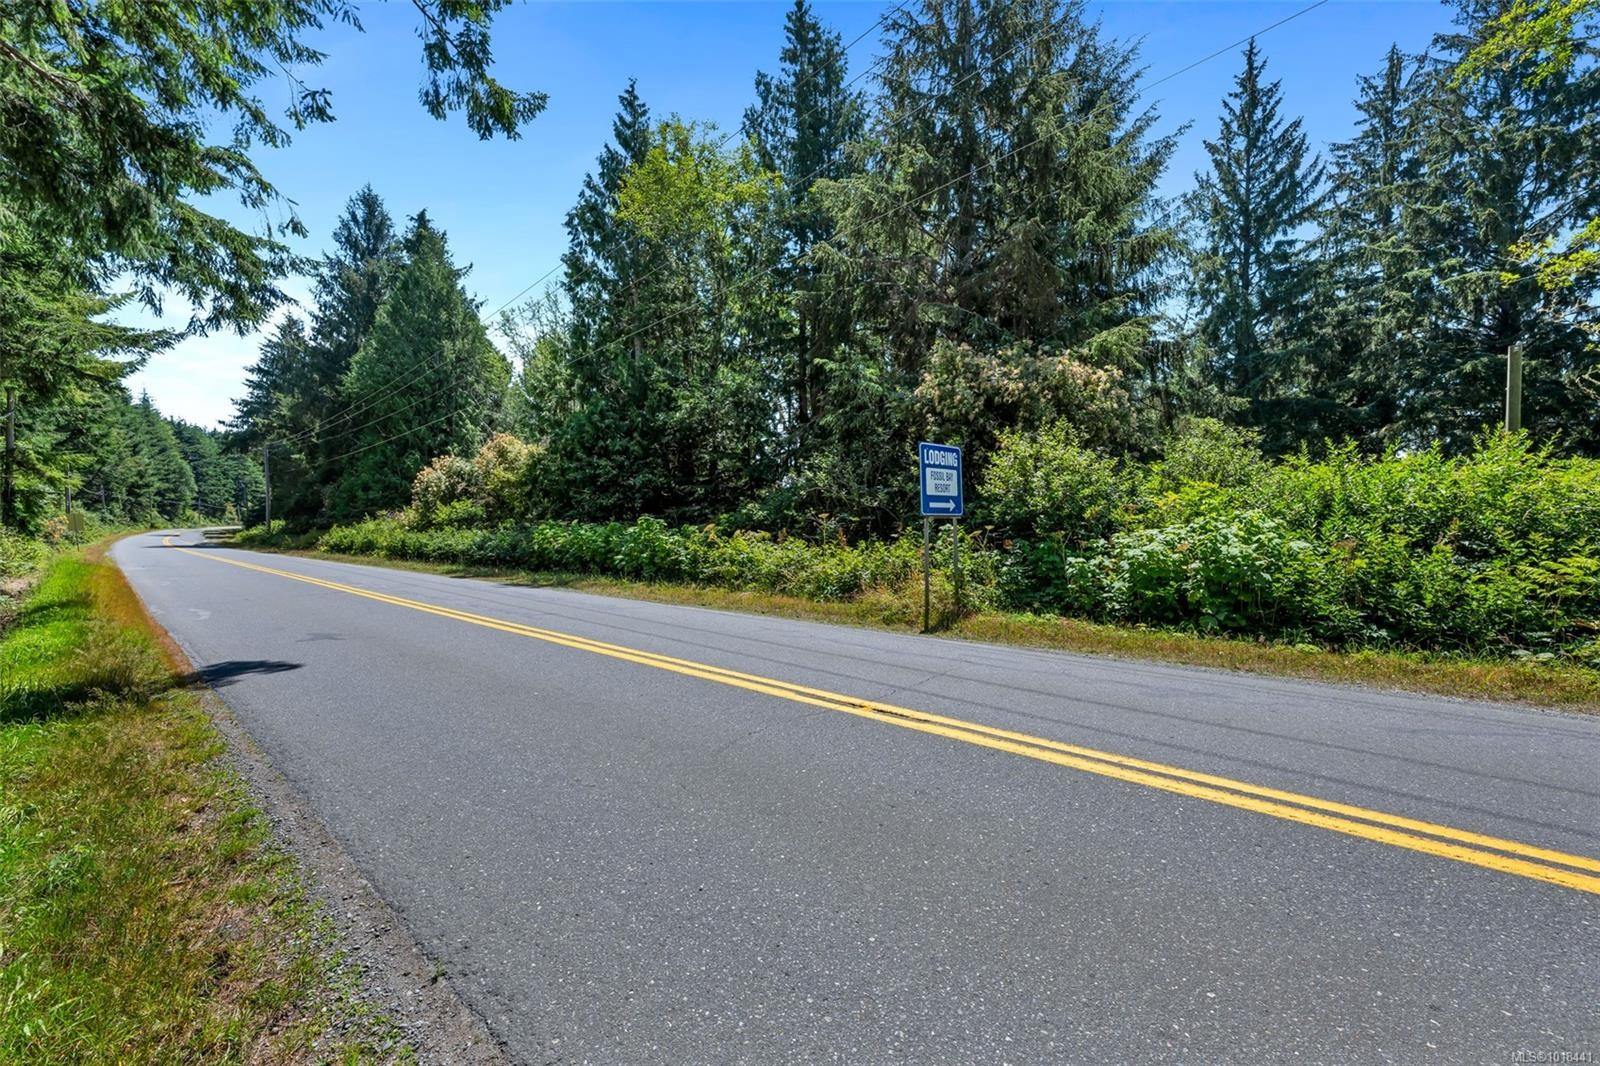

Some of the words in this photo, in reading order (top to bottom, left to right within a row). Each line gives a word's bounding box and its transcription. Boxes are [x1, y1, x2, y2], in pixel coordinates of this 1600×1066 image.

[924, 449, 958, 467] LODGING
[930, 470, 945, 481] FOSSIL
[945, 472, 953, 482] BAY
[935, 483, 951, 493] RESORT
